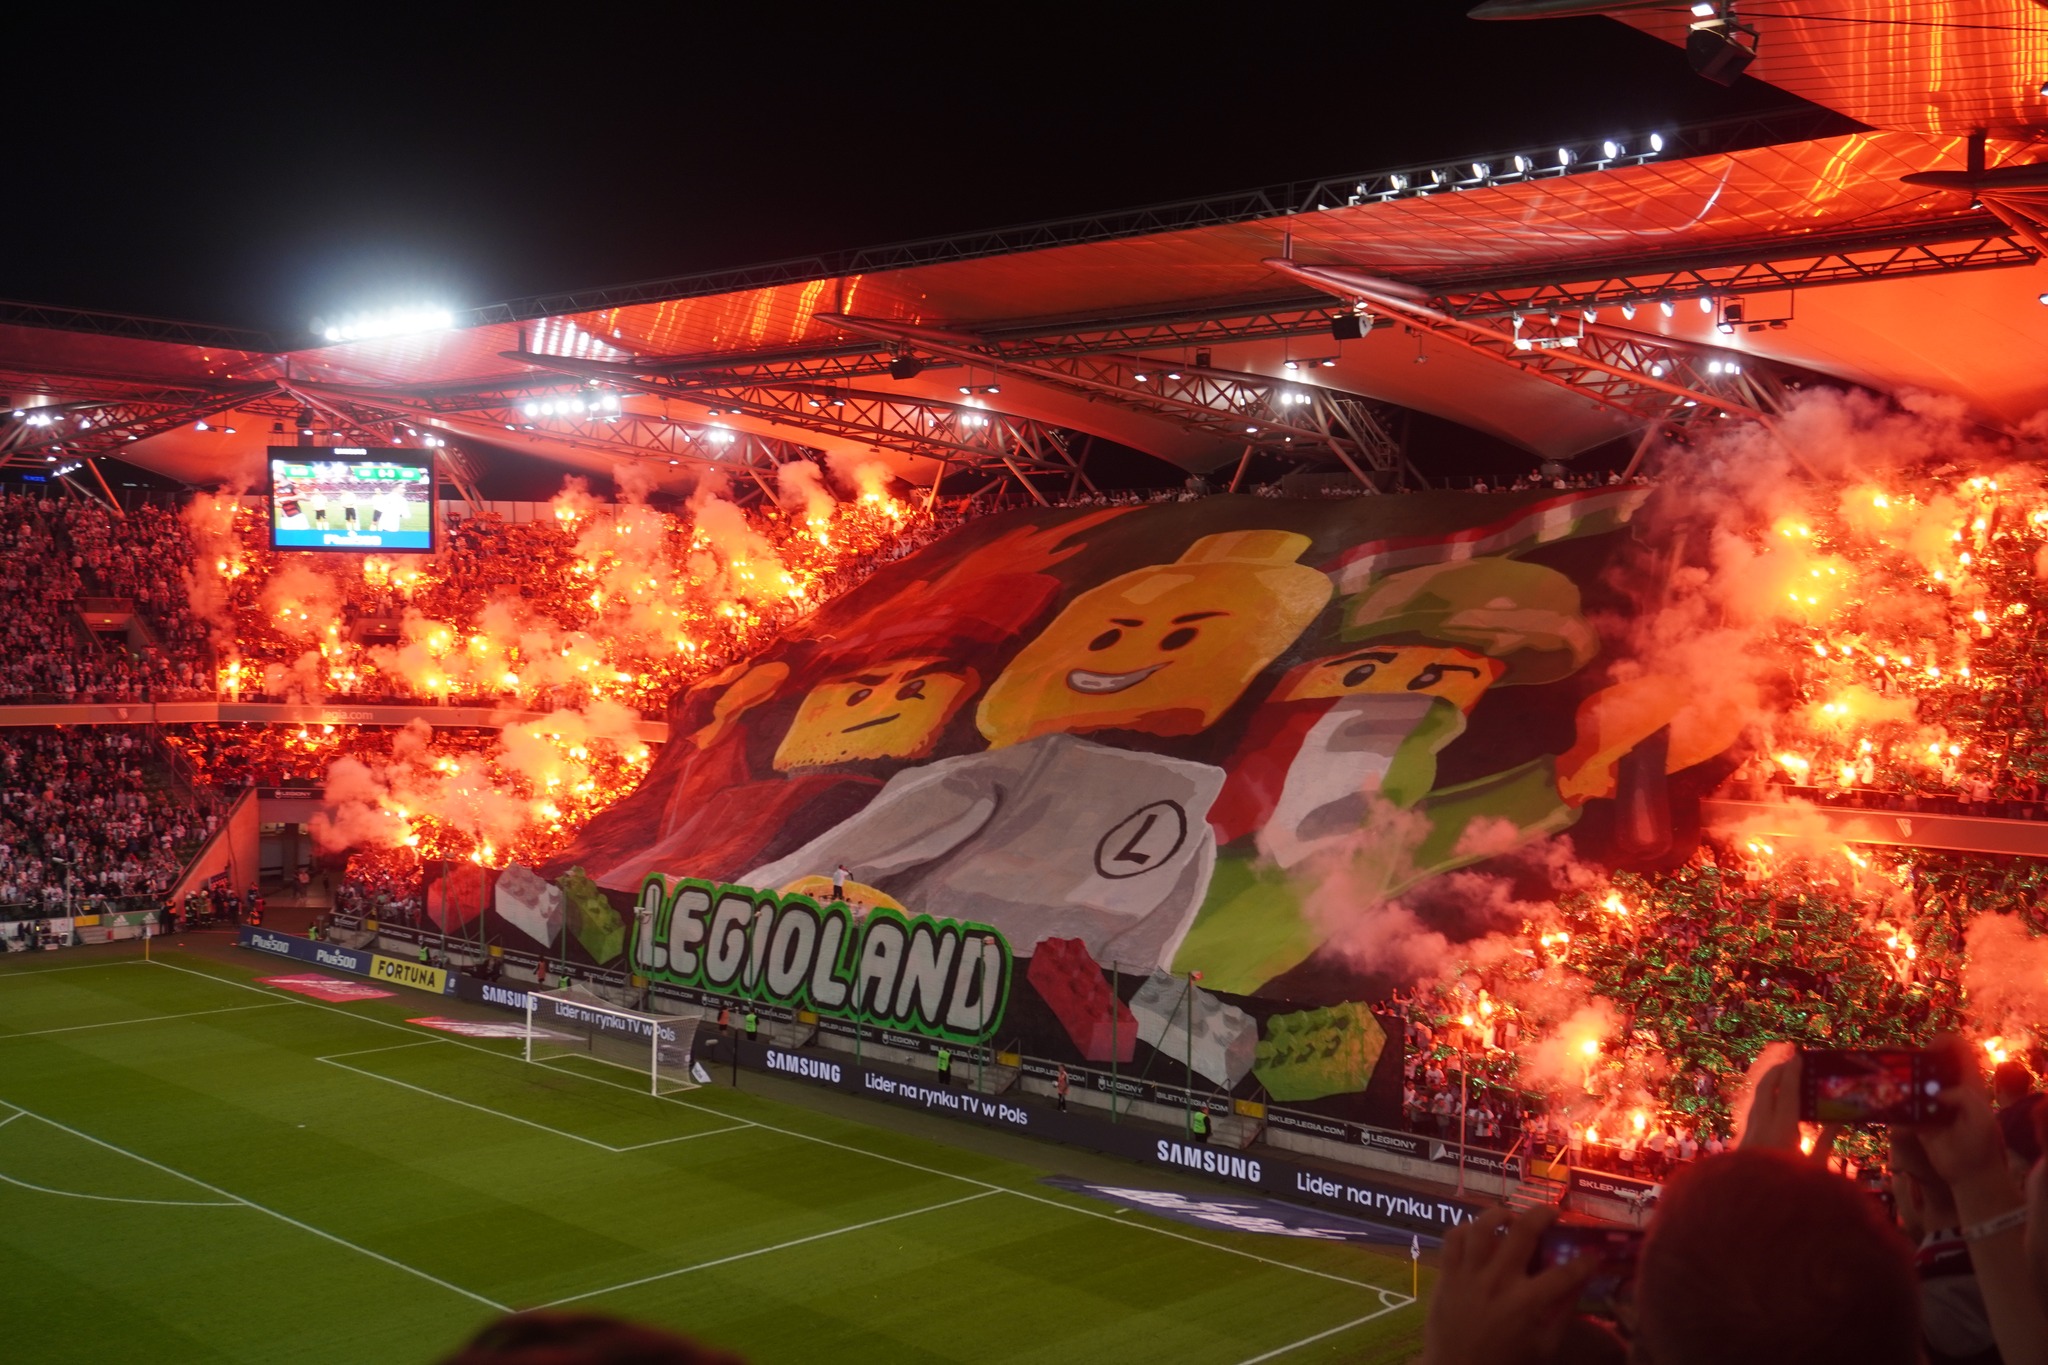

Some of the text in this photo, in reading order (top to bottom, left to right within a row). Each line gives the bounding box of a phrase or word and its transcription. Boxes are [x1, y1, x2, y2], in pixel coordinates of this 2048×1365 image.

[321, 708, 374, 723] legia.com
[252, 934, 290, 954] Plus500
[638, 882, 1002, 1032] LEGIOLAND
[316, 948, 357, 970] Plus500
[377, 959, 436, 988] FORTUNA
[482, 984, 538, 1012] SAMSUNG
[555, 1002, 578, 1020] Lider
[595, 1015, 626, 1030] rynku
[626, 1018, 640, 1033] TV
[642, 1025, 653, 1036] w
[819, 1021, 872, 1038] SKLEP.LEGIAOM
[889, 1035, 920, 1047] LEGIONY
[766, 1050, 841, 1083] SAMSUNG
[865, 1072, 1028, 1125] Lider na rynku TV w Pols
[1267, 1112, 1345, 1137] SKLEP.LEGIA.COM
[1371, 1132, 1417, 1150] LEGIONY
[1156, 1138, 1262, 1183] SAMSUNG
[1297, 1172, 1343, 1199] Lider
[1347, 1185, 1372, 1206] na
[1375, 1191, 1433, 1217] rynku
[1437, 1203, 1463, 1226] TV
